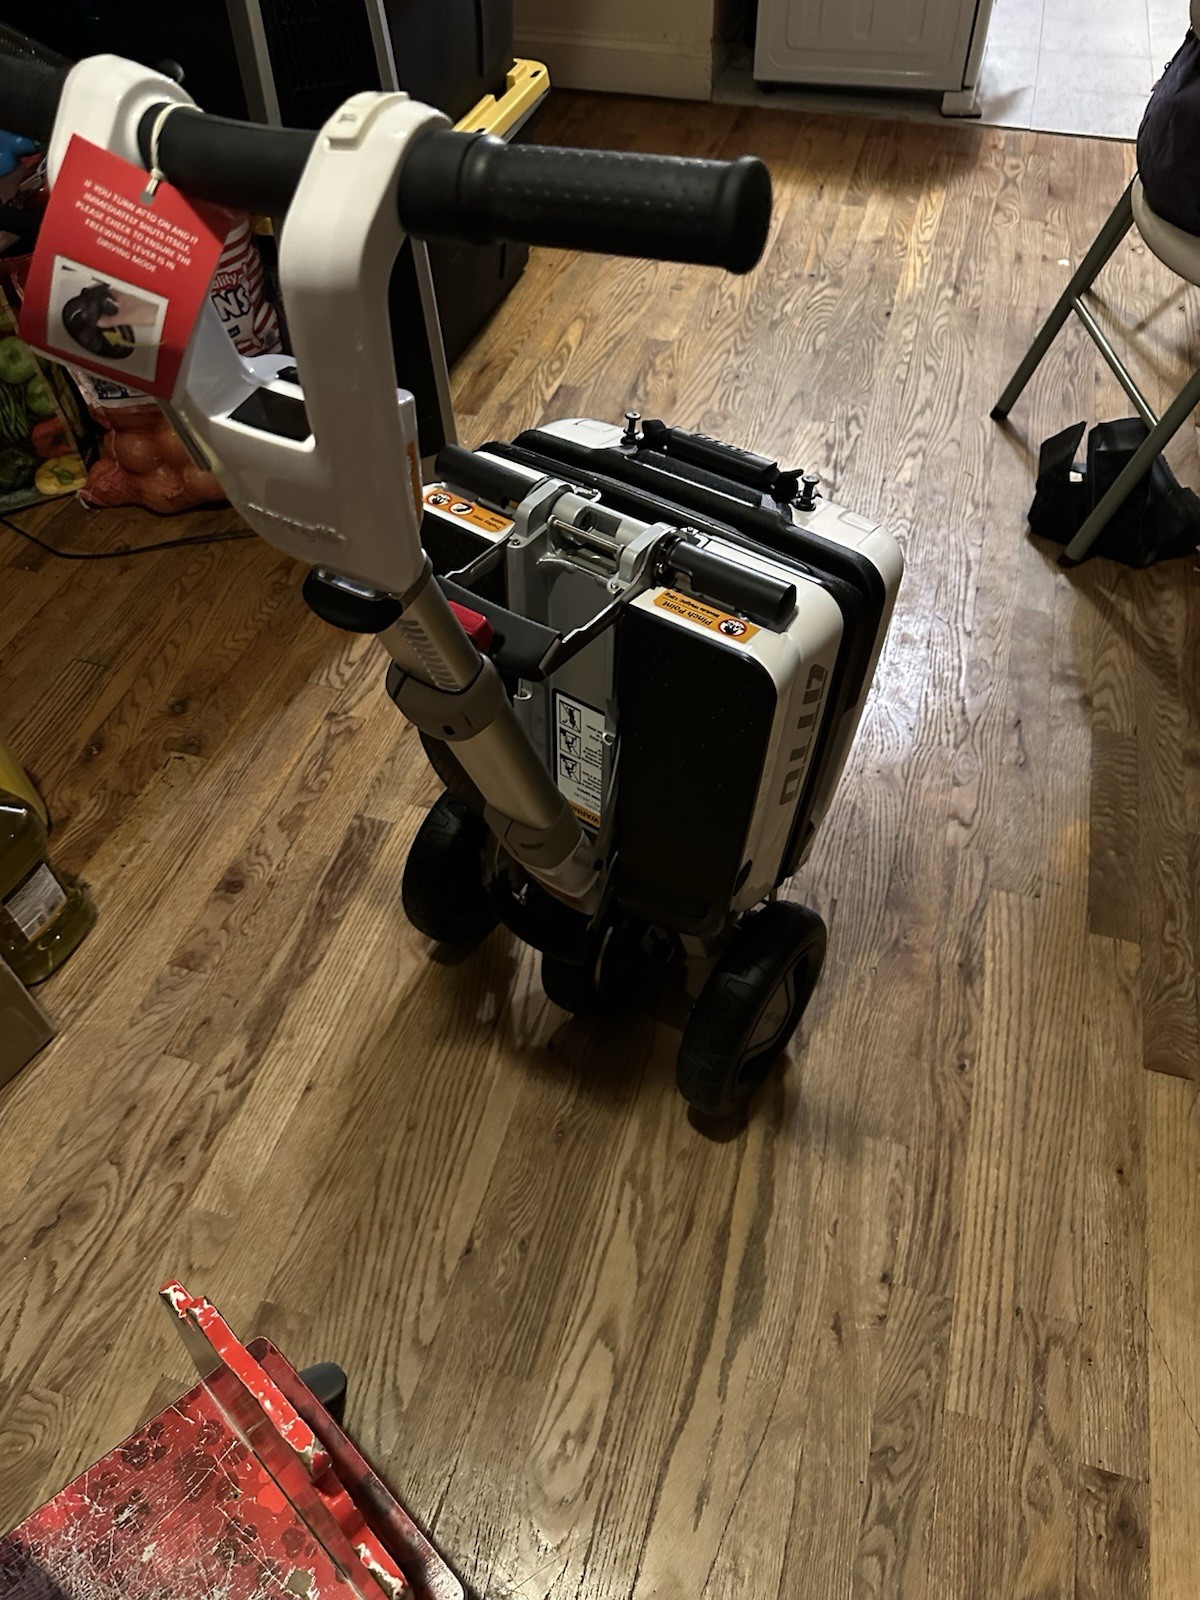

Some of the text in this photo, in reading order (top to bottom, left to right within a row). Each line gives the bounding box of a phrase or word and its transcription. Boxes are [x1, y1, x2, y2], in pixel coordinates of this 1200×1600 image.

[75, 201, 192, 266] PLEASE CHECK TO ENSURE THE
[84, 179, 199, 244] IF YOU TURN ATTO ON AND IT
[84, 192, 138, 226] IMMEDIATELY
[139, 221, 165, 239] SHUTS
[84, 218, 176, 270] FREEWHEEL LEVER IS IN
[97, 237, 157, 272] DRIVING MODE
[211, 274, 238, 290] ality
[662, 600, 713, 626] Pinch Point
